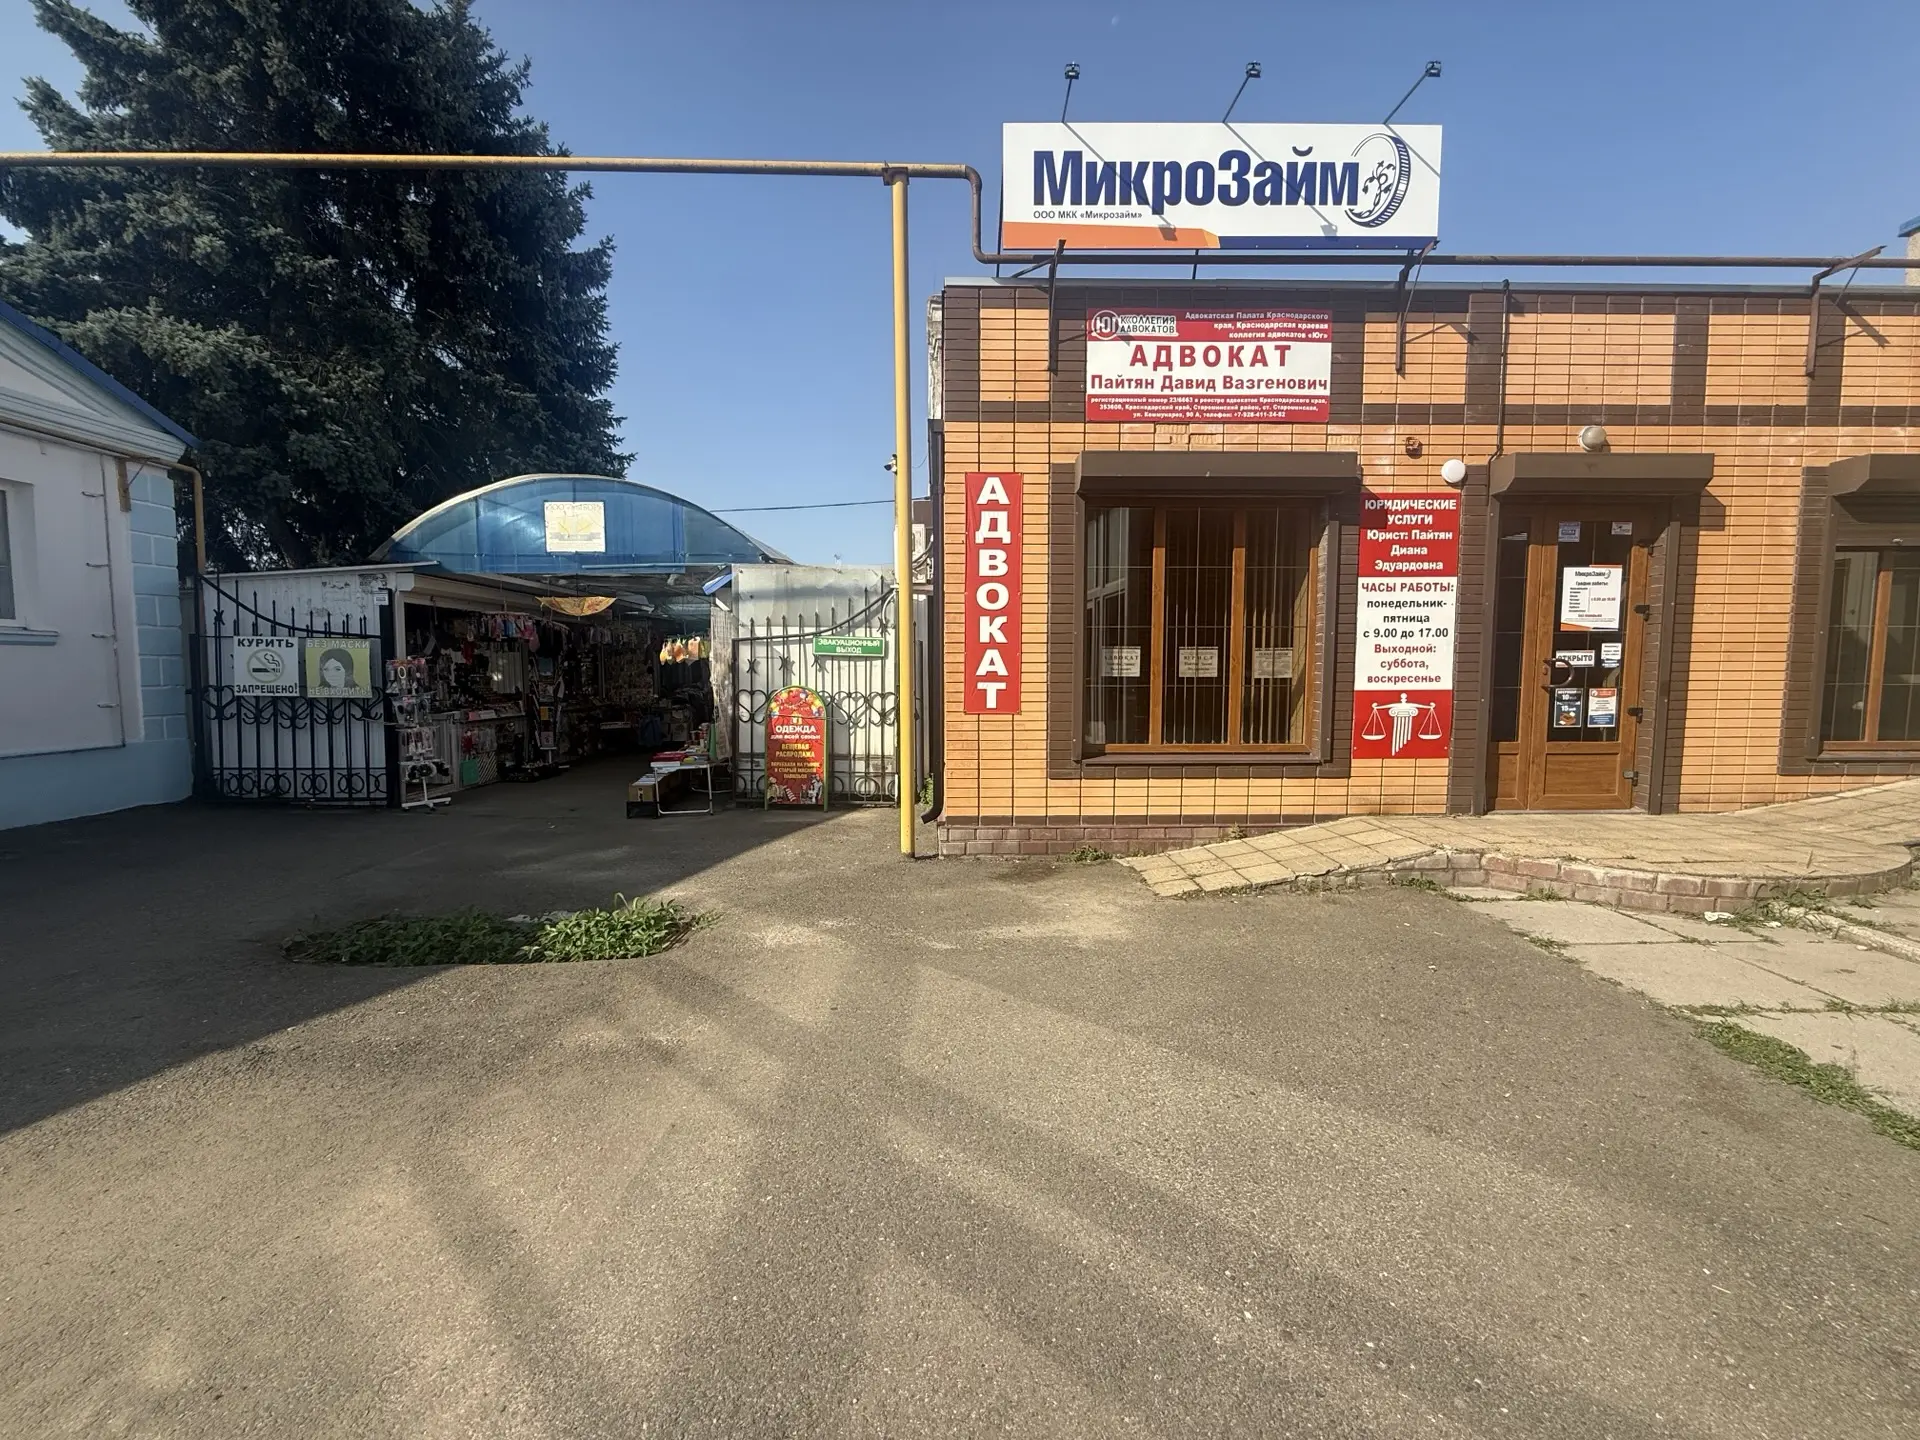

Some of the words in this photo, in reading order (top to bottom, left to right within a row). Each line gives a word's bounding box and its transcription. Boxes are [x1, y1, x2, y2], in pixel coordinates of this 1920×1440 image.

[1033, 146, 1360, 215] МикроЗайм
[1033, 210, 1055, 219] ООО
[1058, 210, 1077, 219] МКК
[1080, 210, 1142, 220] «Микрозайм»
[1266, 312, 1329, 320] Краснодарского
[1120, 325, 1175, 333] АДВОКАТОВ
[1213, 322, 1234, 330] края,
[1236, 321, 1296, 330] Краснодарская
[1298, 322, 1328, 330] краевая
[1229, 331, 1265, 339] коллегия
[1267, 331, 1306, 339] адвокатов
[1308, 331, 1328, 339] «Юг»
[1129, 344, 1291, 372] АДВОКАТ
[1090, 374, 1154, 389] Пайтян
[1160, 375, 1216, 392] Давид
[1222, 375, 1327, 391] Вазгенович
[1364, 499, 1457, 511] ЮРИДИЧЕСКИЕ
[1387, 514, 1433, 525] УСЛУГИ
[1366, 529, 1408, 542] Юрист:
[1411, 529, 1453, 540] Пайтян
[1390, 544, 1428, 556] Диана
[1374, 559, 1443, 572] Эдуардовна
[1361, 582, 1396, 592] ЧАСЫ
[1400, 582, 1454, 592] РАБОТЫ:
[975, 476, 1011, 709] АДВОКАТ
[1366, 600, 1447, 609] понедельник-
[1383, 615, 1430, 624] пятница
[1363, 630, 1370, 638] с
[1373, 628, 1398, 638] 9.00
[1400, 630, 1414, 639] до
[1418, 628, 1449, 638] 17.00
[237, 638, 295, 648] КУРИТЬ
[306, 639, 327, 649] БЕЗ
[331, 639, 370, 649] МАСКИ
[818, 638, 880, 647] ЭВАКУАЦИОННЫЙ
[836, 646, 862, 654] ВЫХОД
[1374, 643, 1437, 655] Выходной:
[1557, 654, 1593, 662] ОТКРЫТО
[1380, 658, 1429, 671] суббота,
[1367, 675, 1441, 685] воскресенье
[235, 682, 298, 695] ЗАПРЕЩЕНО!
[775, 725, 816, 734] ОДЕЖДА
